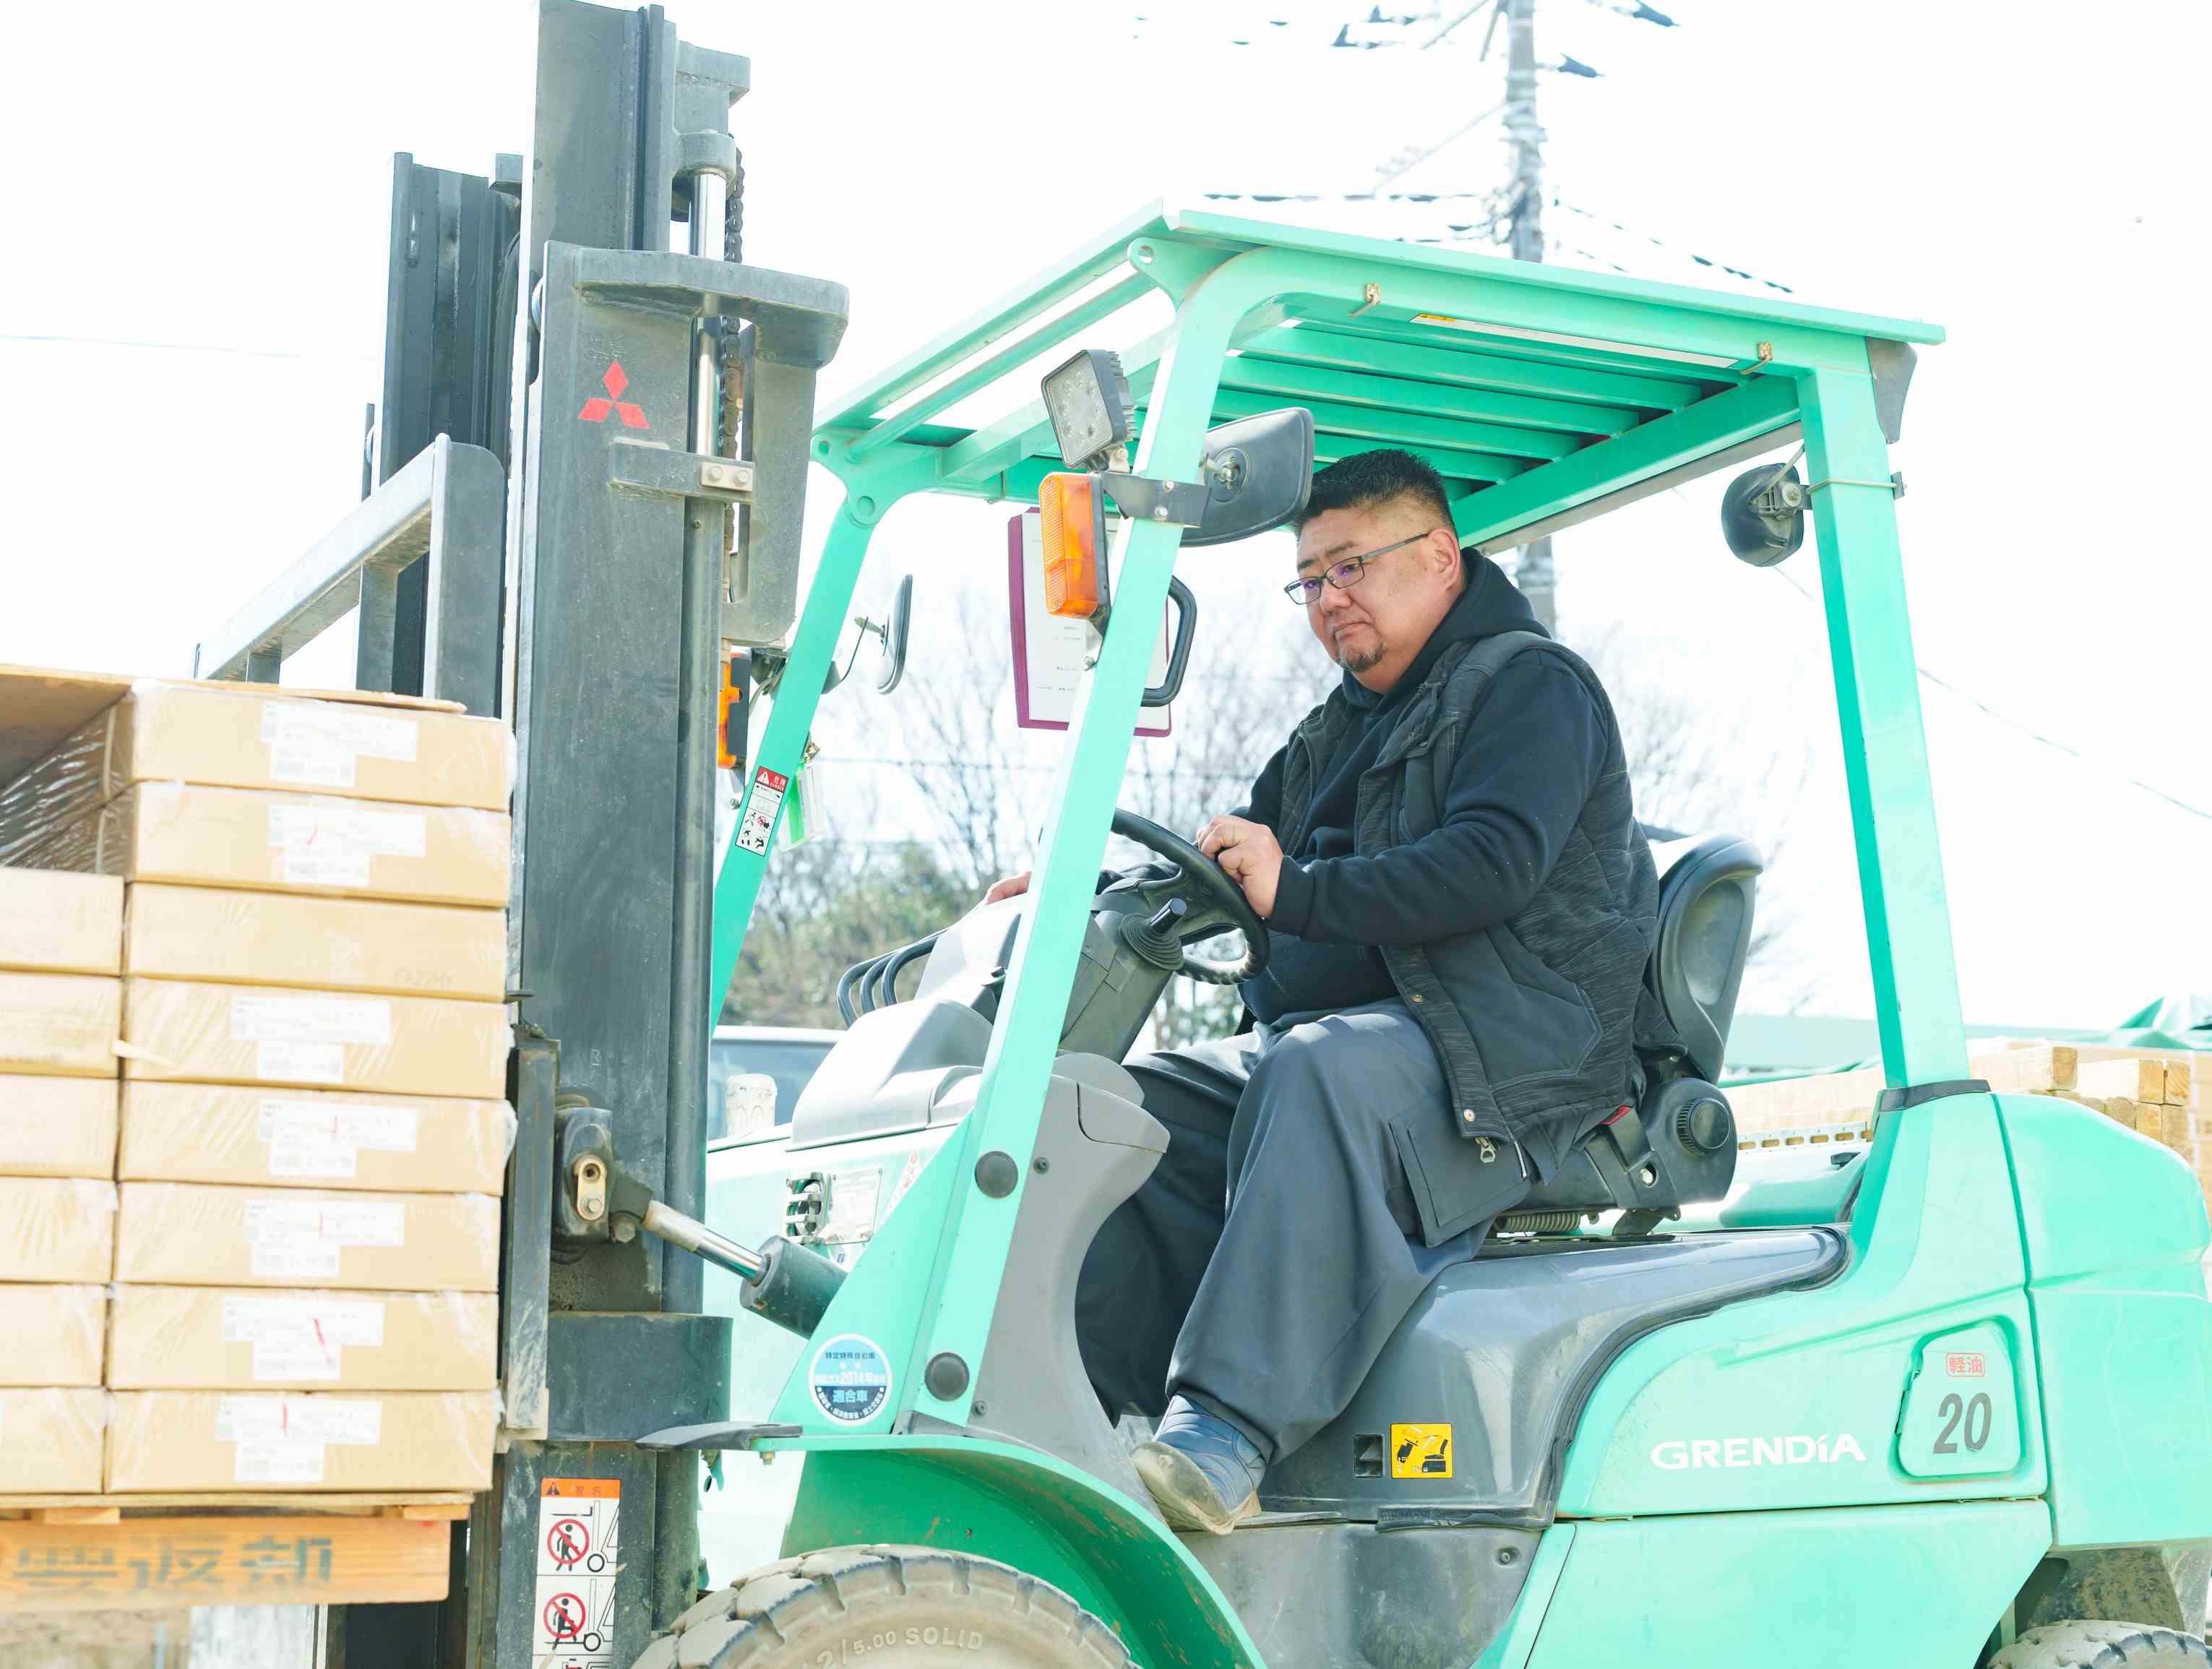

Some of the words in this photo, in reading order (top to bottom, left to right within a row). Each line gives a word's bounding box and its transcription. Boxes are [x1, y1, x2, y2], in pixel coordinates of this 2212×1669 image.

[1948, 1355, 1984, 1373] 軽油
[832, 1389, 869, 1403] 適合車
[1932, 1392, 1992, 1454] 20
[801, 1631, 897, 1669] 2/5.00
[905, 1626, 984, 1650] SOLID
